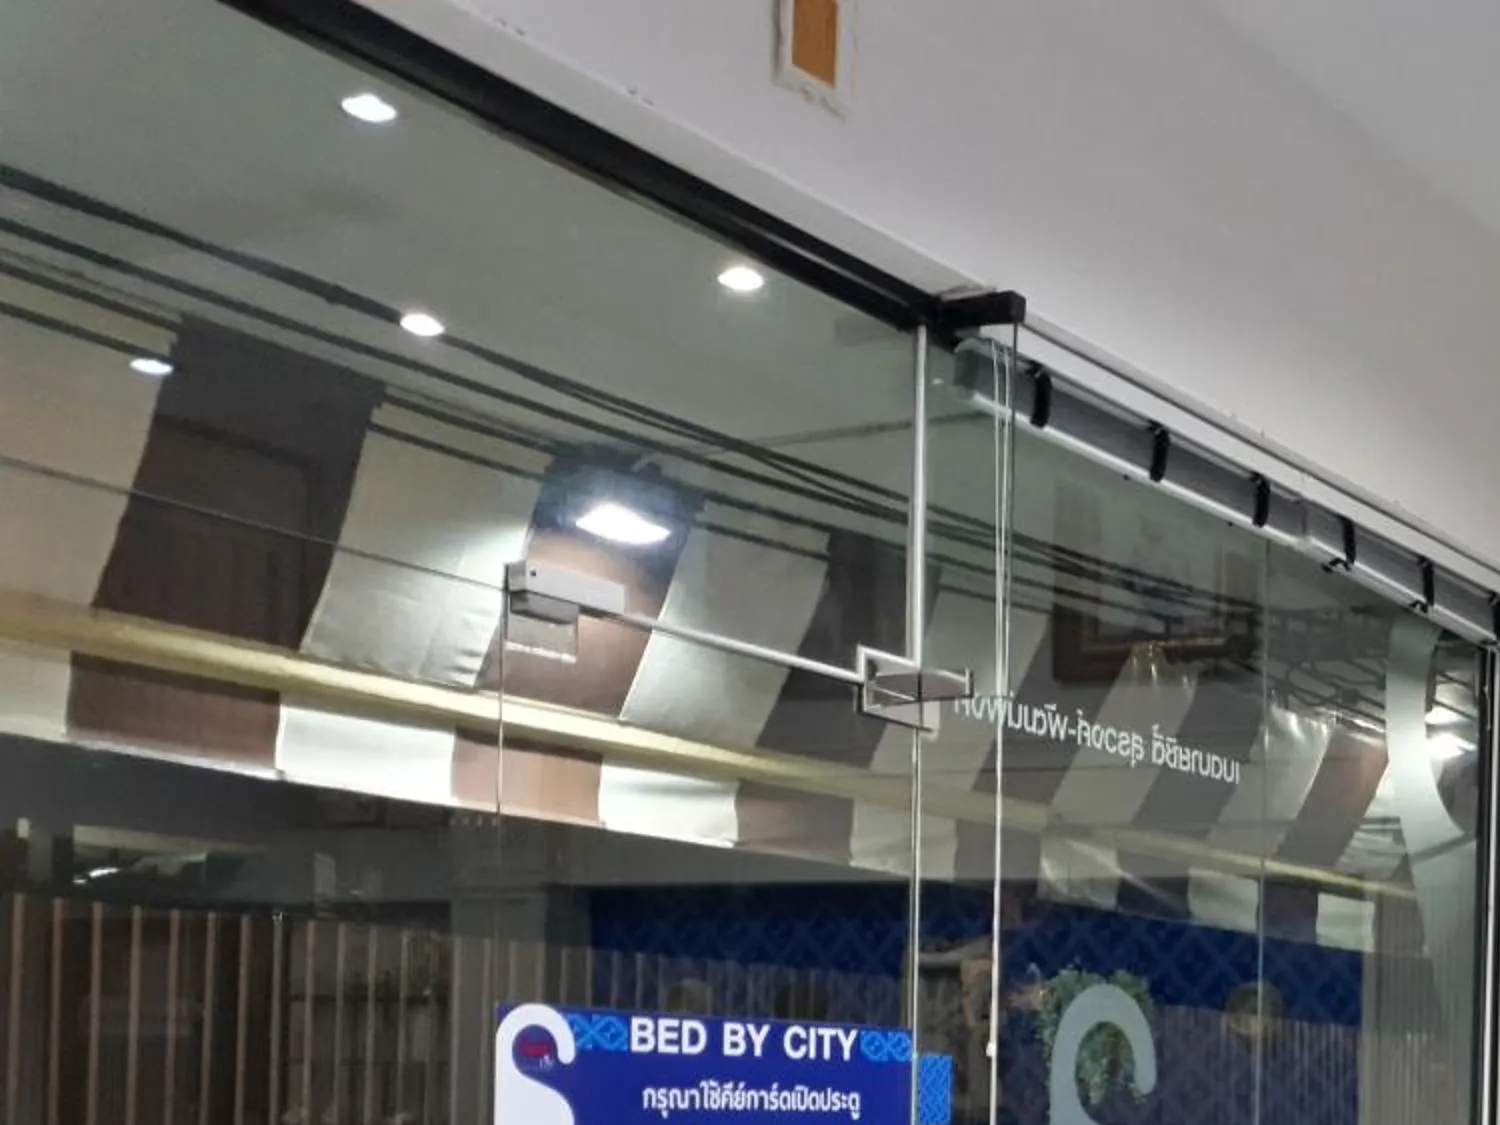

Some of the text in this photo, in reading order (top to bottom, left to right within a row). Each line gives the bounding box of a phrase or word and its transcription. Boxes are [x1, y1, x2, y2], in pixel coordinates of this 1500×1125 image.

[630, 1016, 859, 1062] BED BY CITY
